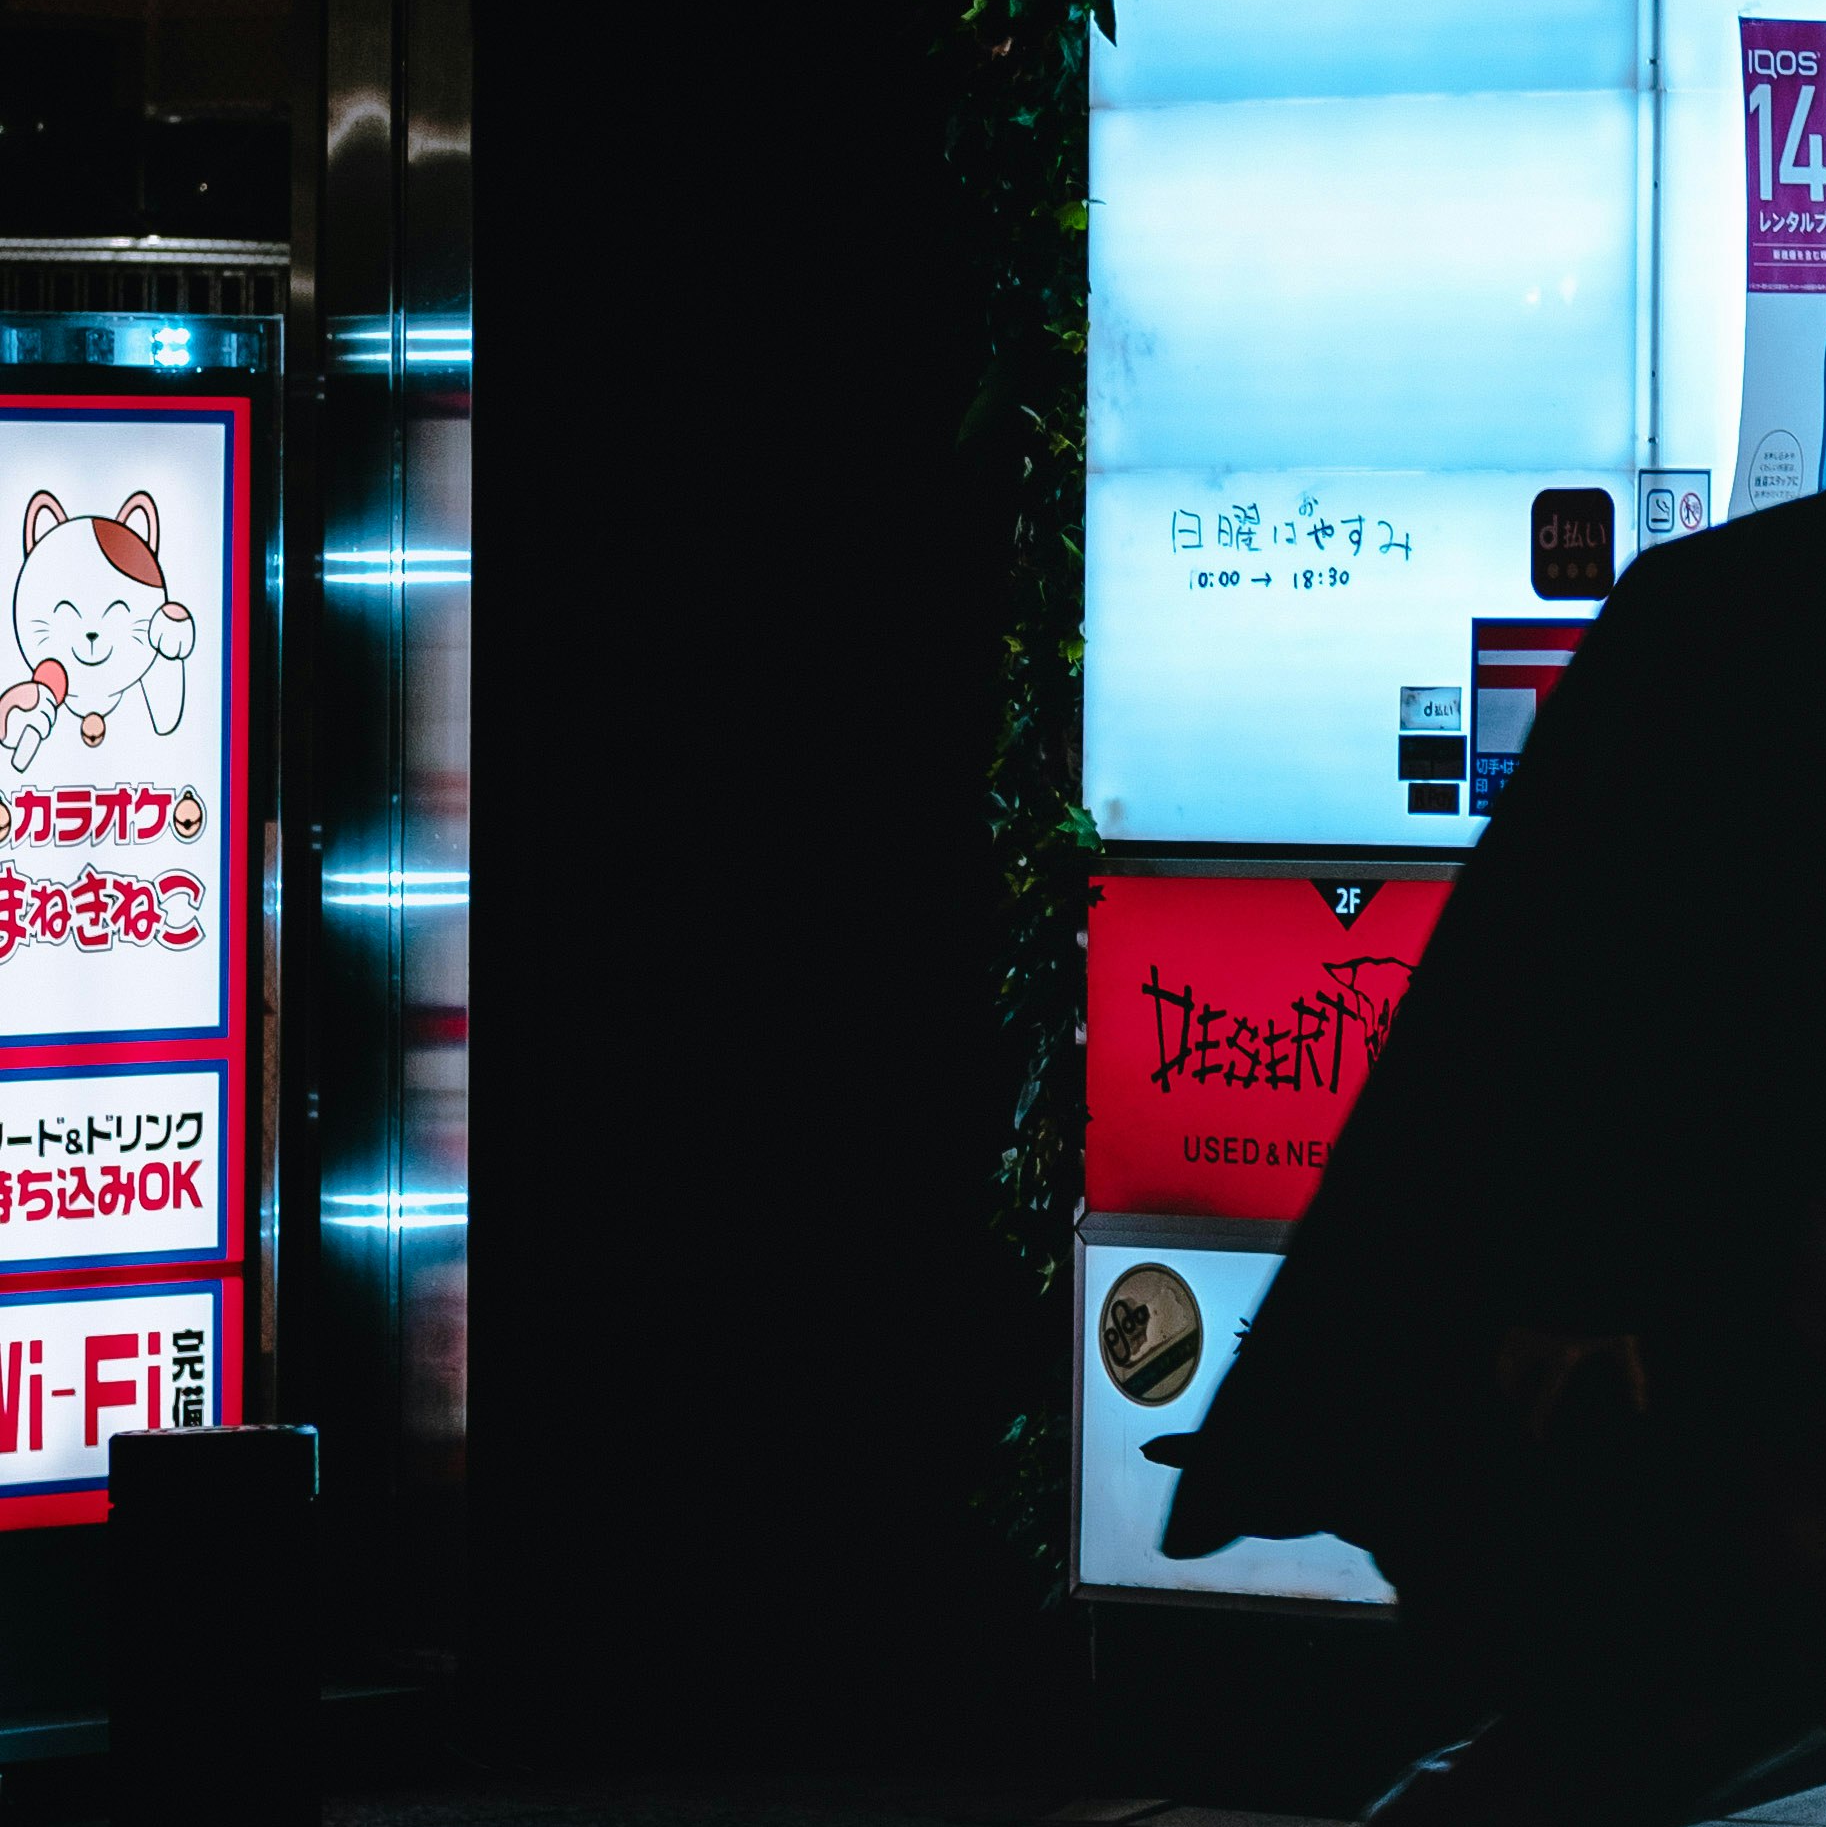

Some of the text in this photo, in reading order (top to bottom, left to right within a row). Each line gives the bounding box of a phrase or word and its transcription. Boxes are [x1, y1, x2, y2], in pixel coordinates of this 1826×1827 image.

[1749, 49, 1817, 80] IQOS
[1293, 566, 1350, 590] 18:30
[14, 787, 172, 842] カラオケ
[1335, 887, 1361, 914] 2F
[1142, 964, 1358, 1094] DESERT
[0, 1111, 203, 1158] ード&ドリンク
[1183, 1135, 1260, 1165] USED
[1286, 1140, 1334, 1169] NE
